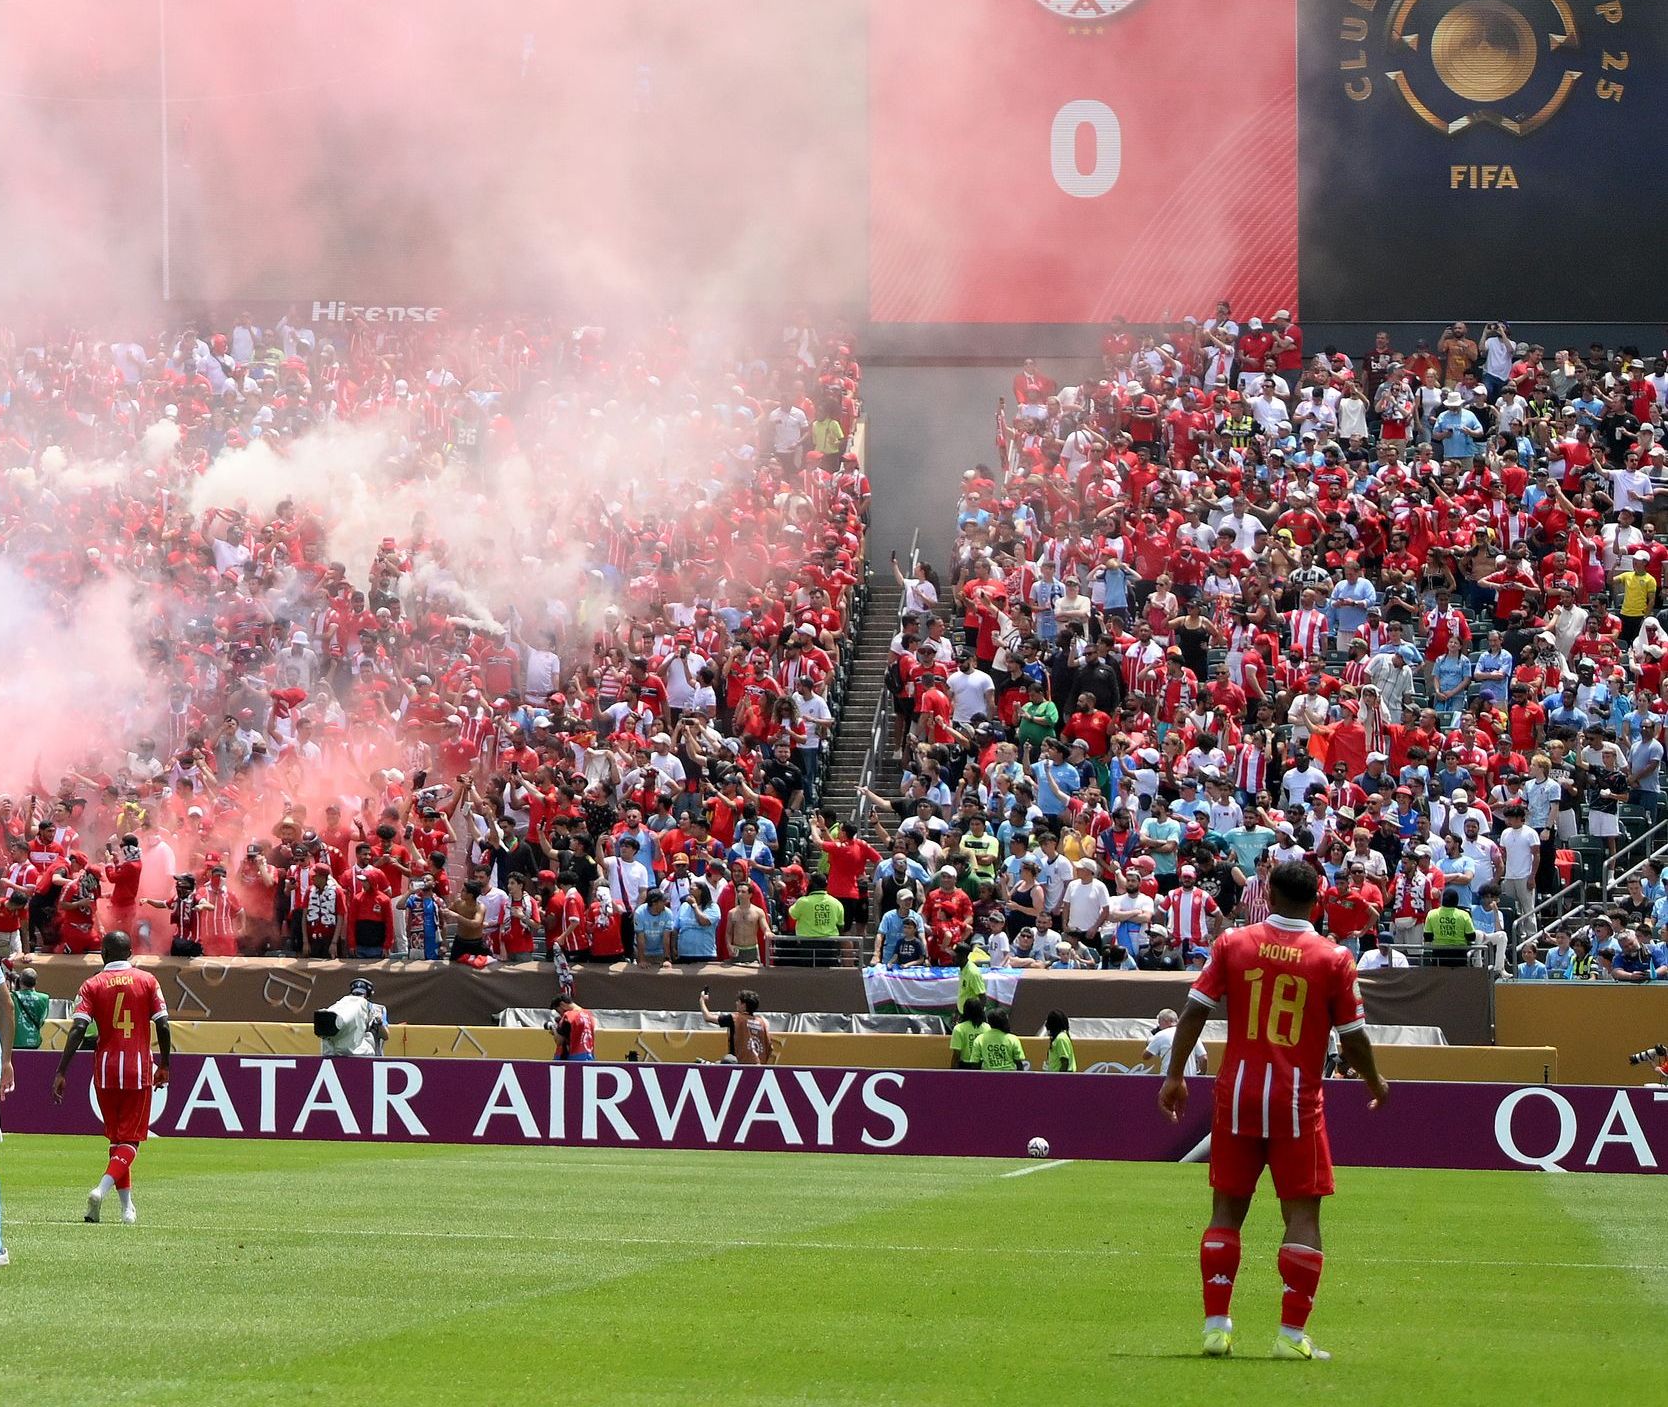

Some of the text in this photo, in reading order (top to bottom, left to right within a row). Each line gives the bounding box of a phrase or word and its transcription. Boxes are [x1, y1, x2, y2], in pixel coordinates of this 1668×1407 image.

[1594, 49, 1631, 103] 25
[1049, 99, 1122, 198] 0
[1449, 164, 1521, 190] FIFA
[311, 300, 443, 322] Hisense
[1257, 941, 1304, 965] MOUFI
[105, 975, 135, 989] LORCH
[113, 991, 135, 1039] 4
[1243, 967, 1309, 1048] 18
[987, 1044, 1006, 1052] CSC
[472, 1061, 909, 1148] AIRWAYS
[1494, 1087, 1668, 1173] QA
